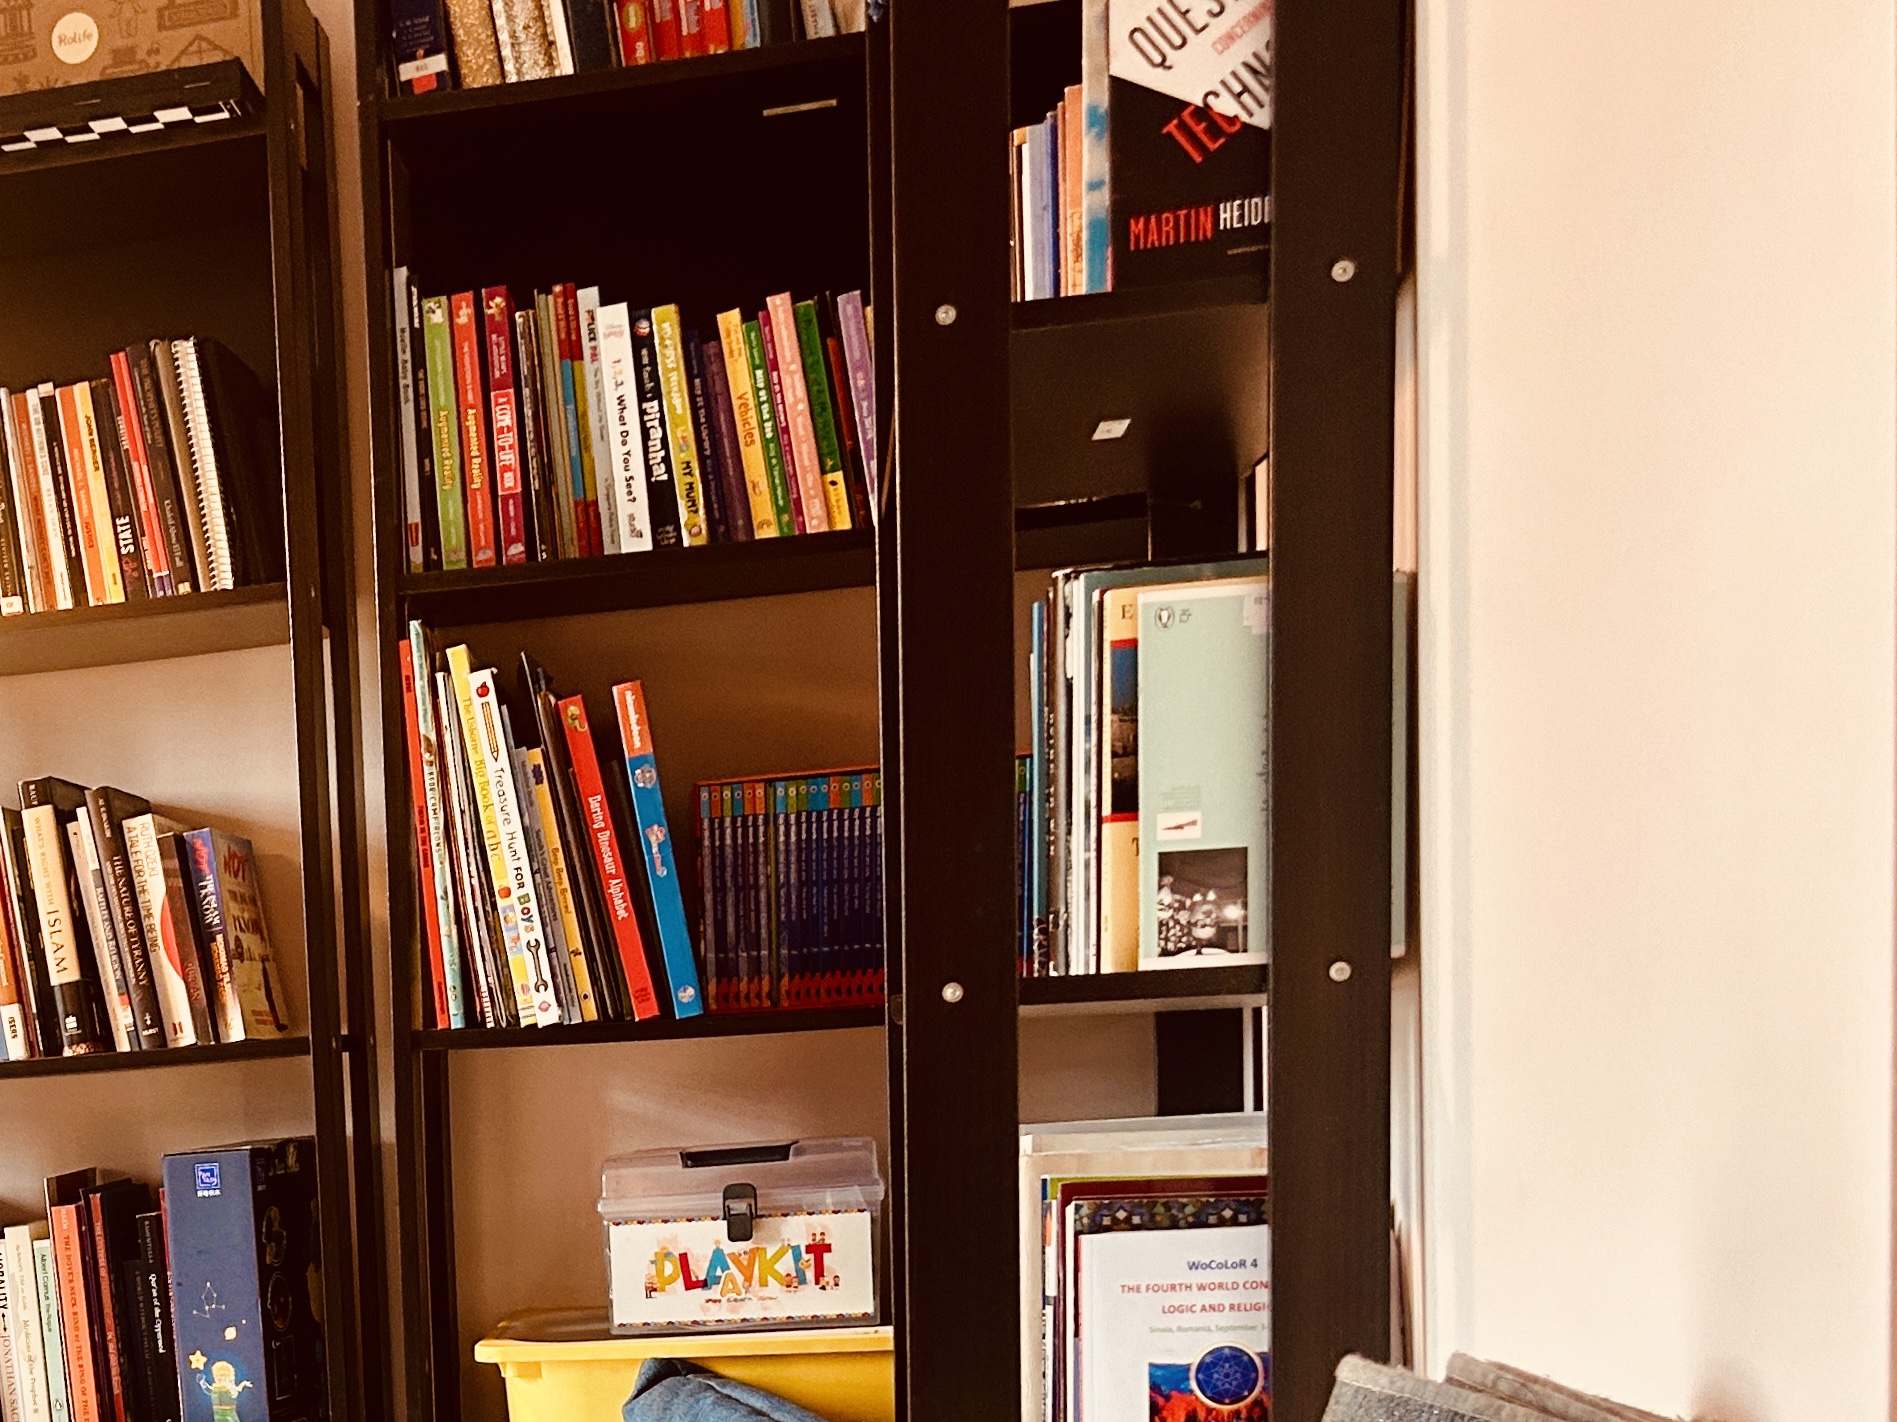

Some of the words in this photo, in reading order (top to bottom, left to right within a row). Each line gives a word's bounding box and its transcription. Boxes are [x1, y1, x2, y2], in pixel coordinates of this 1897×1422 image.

[1129, 204, 1215, 251] MARTIN
[84, 414, 94, 436] JOHN
[616, 394, 628, 426] What
[735, 391, 757, 449] Vehicles
[438, 410, 451, 457] Augmented
[466, 408, 478, 457] Augmented
[619, 430, 631, 446] Do
[641, 400, 669, 482] piranha!
[88, 439, 100, 472] BERGER
[621, 449, 633, 473] You
[681, 460, 695, 478] MY
[442, 458, 456, 490] Reality
[470, 458, 483, 489] Reality
[623, 476, 637, 503] See?
[684, 481, 698, 514] MUM?
[115, 516, 135, 554] STATE
[475, 780, 492, 813] Book
[492, 767, 512, 827] Treasure
[587, 794, 606, 829] Daring
[34, 817, 45, 850] WHAT'S
[126, 826, 137, 834] A
[127, 834, 142, 857] TALE
[140, 822, 153, 848] RUTH
[506, 830, 521, 863] Hunt
[596, 831, 618, 875] Dinosaur
[39, 852, 50, 880] RIGHT
[112, 854, 123, 876] THE
[134, 858, 145, 877] FOR
[144, 850, 159, 877] OZEKI
[513, 867, 526, 891] FOR
[43, 882, 54, 906] WITH
[116, 877, 133, 921] NATURE
[137, 878, 149, 896] THE
[608, 879, 630, 921] Alphabet
[140, 898, 154, 922] TIME
[517, 893, 537, 934] Boys
[46, 909, 68, 974] ISLAM
[126, 921, 135, 935] OF
[144, 923, 160, 954] BEING
[127, 936, 148, 987] TYRANNY
[653, 1240, 832, 1293] PLAYKIT
[1187, 1259, 1247, 1271] WoCoLoR
[1250, 1259, 1258, 1268] 4
[1120, 1284, 1142, 1294] THE
[1145, 1283, 1192, 1293] FOURTH
[1196, 1281, 1239, 1291] WORLD
[1162, 1304, 1196, 1314] LOGIC
[1199, 1303, 1225, 1313] AND
